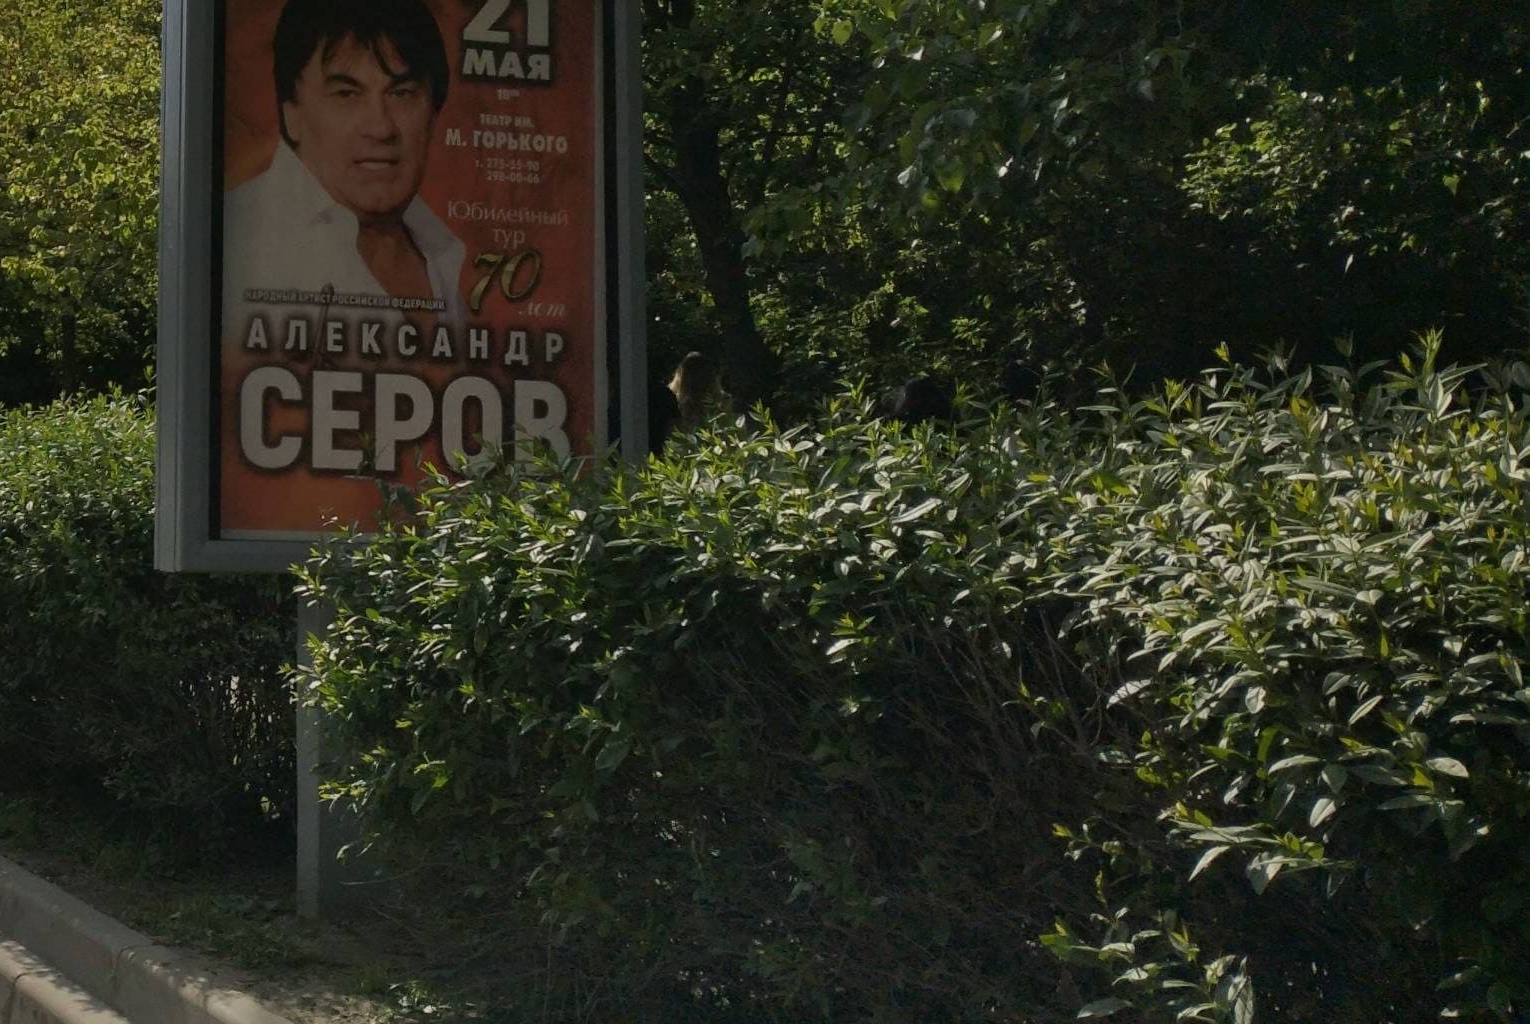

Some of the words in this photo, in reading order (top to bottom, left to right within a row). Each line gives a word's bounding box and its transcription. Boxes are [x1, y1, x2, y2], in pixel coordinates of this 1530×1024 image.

[462, 47, 551, 81] МАЯ
[479, 112, 512, 128] ТЕАТР
[445, 127, 468, 147] М.
[472, 129, 568, 154] ГОРЬКОГО
[447, 199, 569, 226] Юбилейный
[491, 228, 527, 249] тур
[469, 249, 542, 312] 70
[244, 288, 297, 304] НАРОДНЫЙ
[299, 291, 333, 306] АРТИСТ
[333, 293, 390, 308] РОССИЙСКОЙ
[392, 297, 446, 311] ФЕДЕРАЦИИ
[517, 301, 566, 318] лет
[246, 317, 565, 366] АЛЕКСАНДР
[240, 365, 571, 474] СЕРОВ
